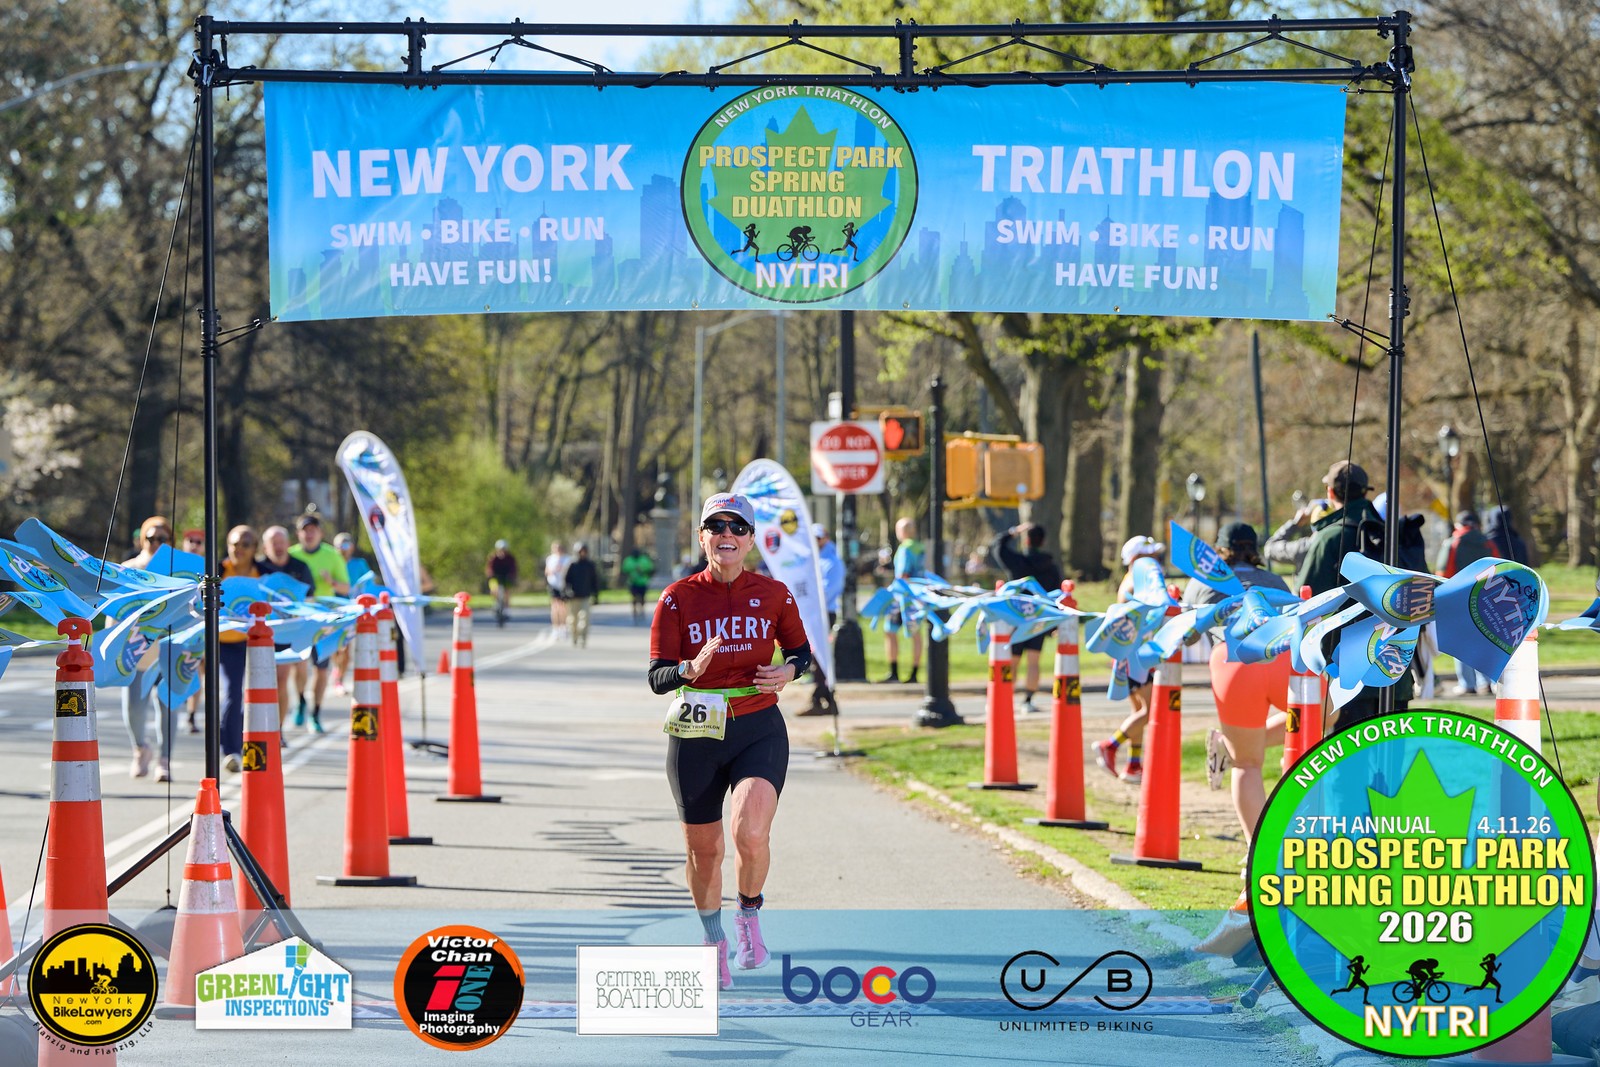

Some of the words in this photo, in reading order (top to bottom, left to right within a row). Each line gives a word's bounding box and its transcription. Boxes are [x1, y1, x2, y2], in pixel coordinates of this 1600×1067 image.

[715, 98, 750, 128] NEW
[751, 86, 799, 104] YORK
[804, 86, 892, 129] TRIATHLON
[311, 146, 449, 198] NEW
[463, 144, 634, 193] YORK
[699, 146, 831, 168] PROSPECT
[836, 146, 904, 168] PARK
[750, 171, 845, 193] SPRING
[972, 144, 1295, 200] TRIATHLON
[732, 196, 862, 218] DUATHLON
[330, 220, 411, 248] SWIM
[440, 218, 510, 244] BIKE
[539, 217, 604, 241] RUN
[996, 219, 1080, 246] SWIM
[1109, 222, 1179, 248] BIKE
[1208, 225, 1274, 251] RUN
[390, 261, 469, 287] HAVE
[478, 258, 552, 284] FUN!
[755, 262, 849, 289] NYTRI
[1055, 262, 1134, 288] HAVE
[1144, 265, 1218, 291] FUN!
[821, 435, 841, 450] DO
[846, 435, 871, 450] NOT
[1470, 595, 1495, 640] ESTABLISHED
[1475, 564, 1525, 648] NYTR
[688, 616, 771, 644] BIKERY
[679, 703, 707, 723] 26
